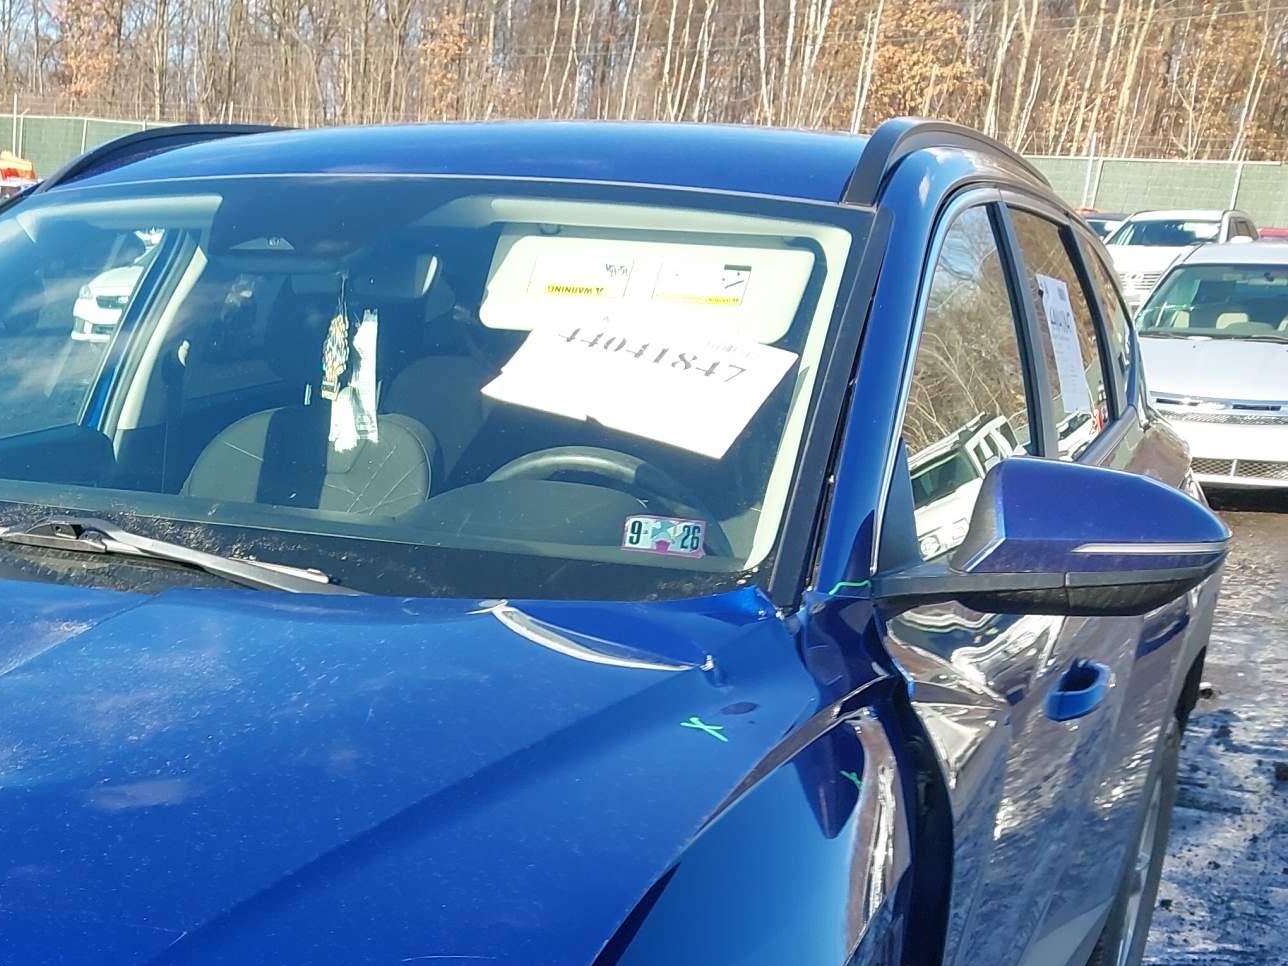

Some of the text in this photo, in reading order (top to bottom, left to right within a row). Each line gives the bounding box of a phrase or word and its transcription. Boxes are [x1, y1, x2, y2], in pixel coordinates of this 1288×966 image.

[558, 328, 747, 382] 44041847
[629, 520, 701, 550] 9 26
